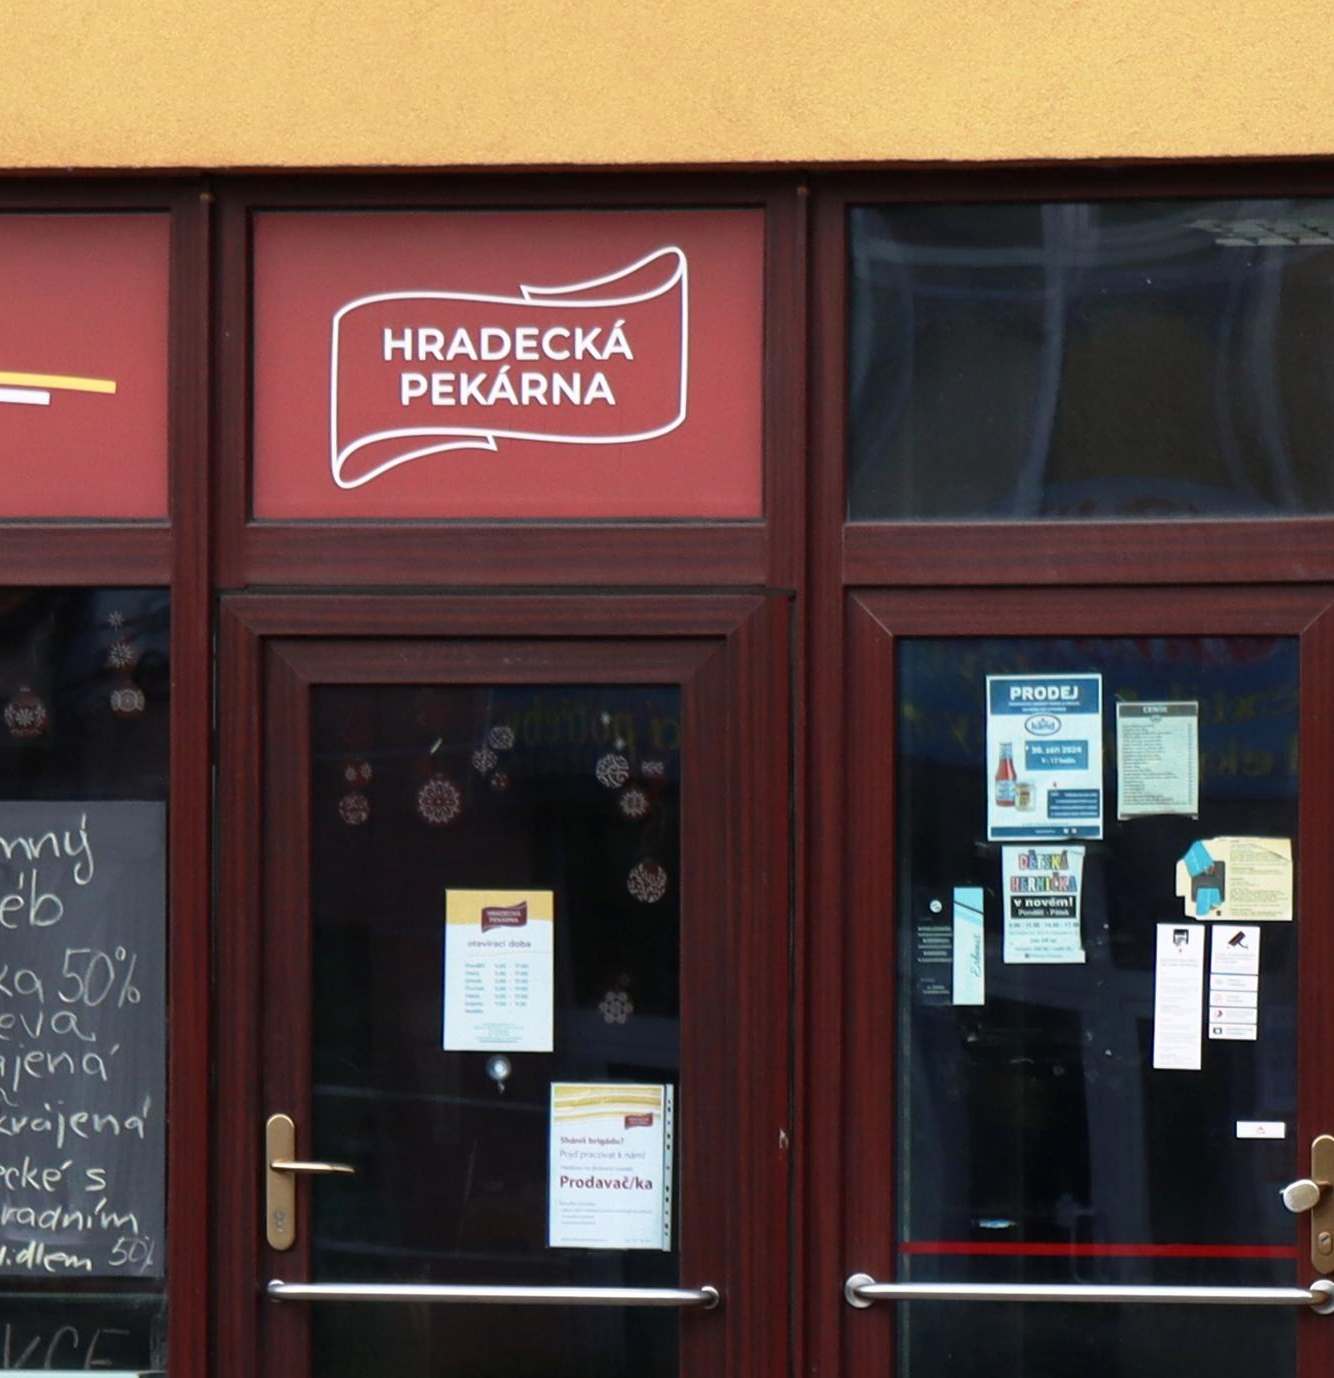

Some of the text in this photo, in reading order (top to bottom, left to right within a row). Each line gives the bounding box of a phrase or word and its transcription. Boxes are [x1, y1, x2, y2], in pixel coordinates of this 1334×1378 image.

[382, 319, 634, 361] HRADECKÁ
[400, 365, 616, 406] PEKÁRNA
[1009, 686, 1079, 701] PRODEJ
[1018, 849, 1069, 871] DĚTSKÁ
[1010, 872, 1077, 892] HERNIČKA
[58, 946, 141, 1008] 50%
[559, 1175, 653, 1190] Prodavač/ka
